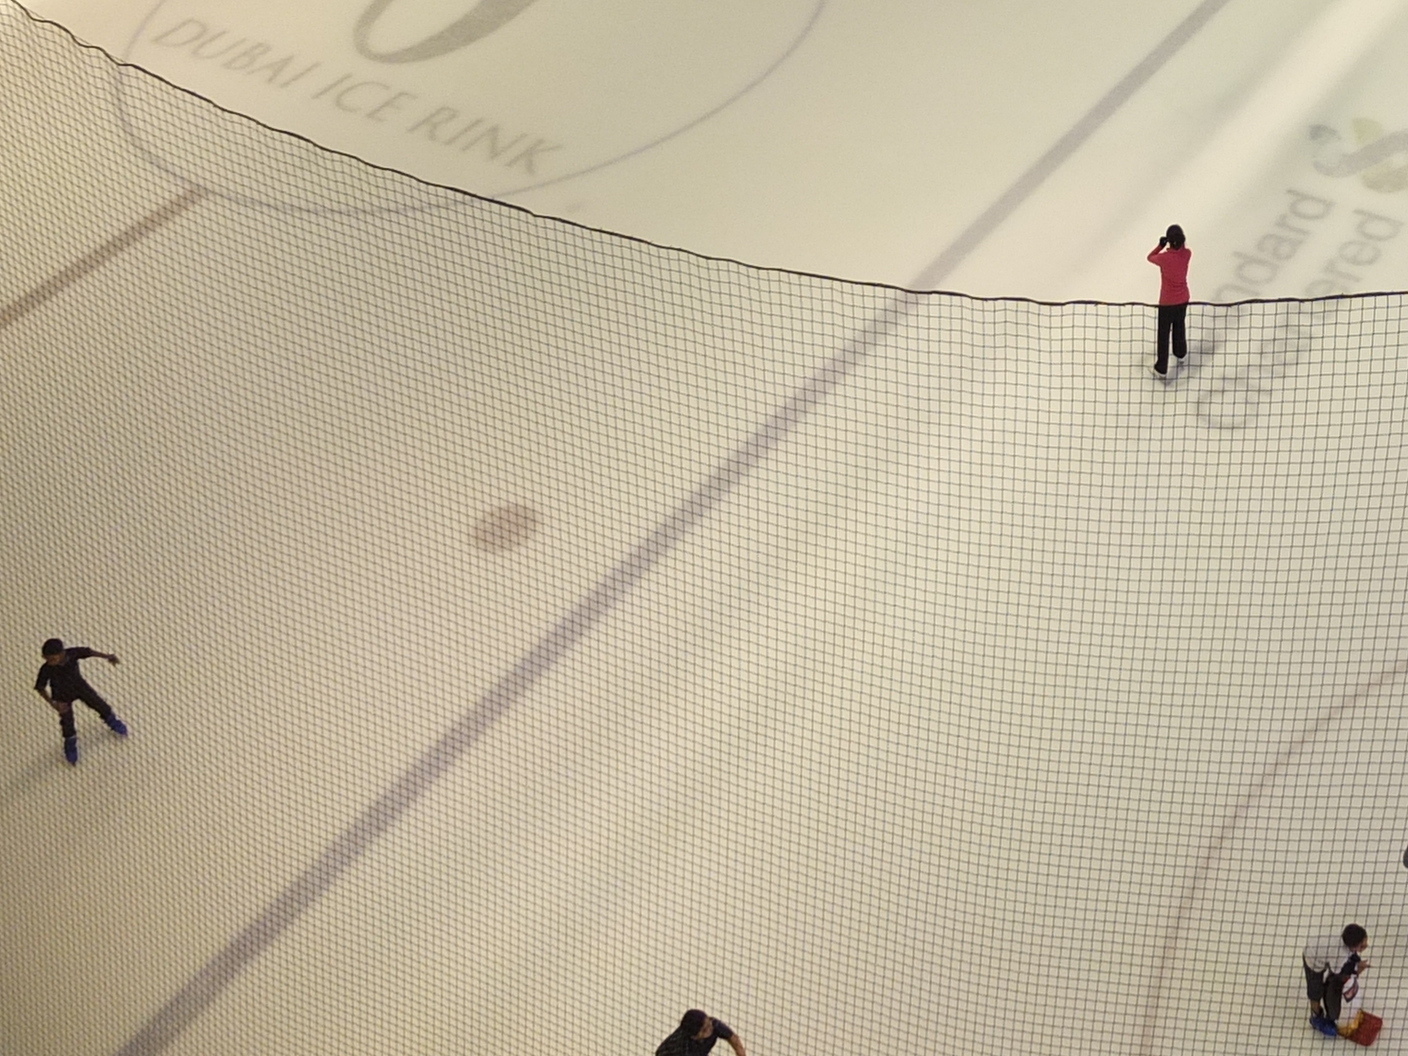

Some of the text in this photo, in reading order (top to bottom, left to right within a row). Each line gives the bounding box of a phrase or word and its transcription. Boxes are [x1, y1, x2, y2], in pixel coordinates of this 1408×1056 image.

[152, 17, 564, 176] DUBAI ICE RINK
